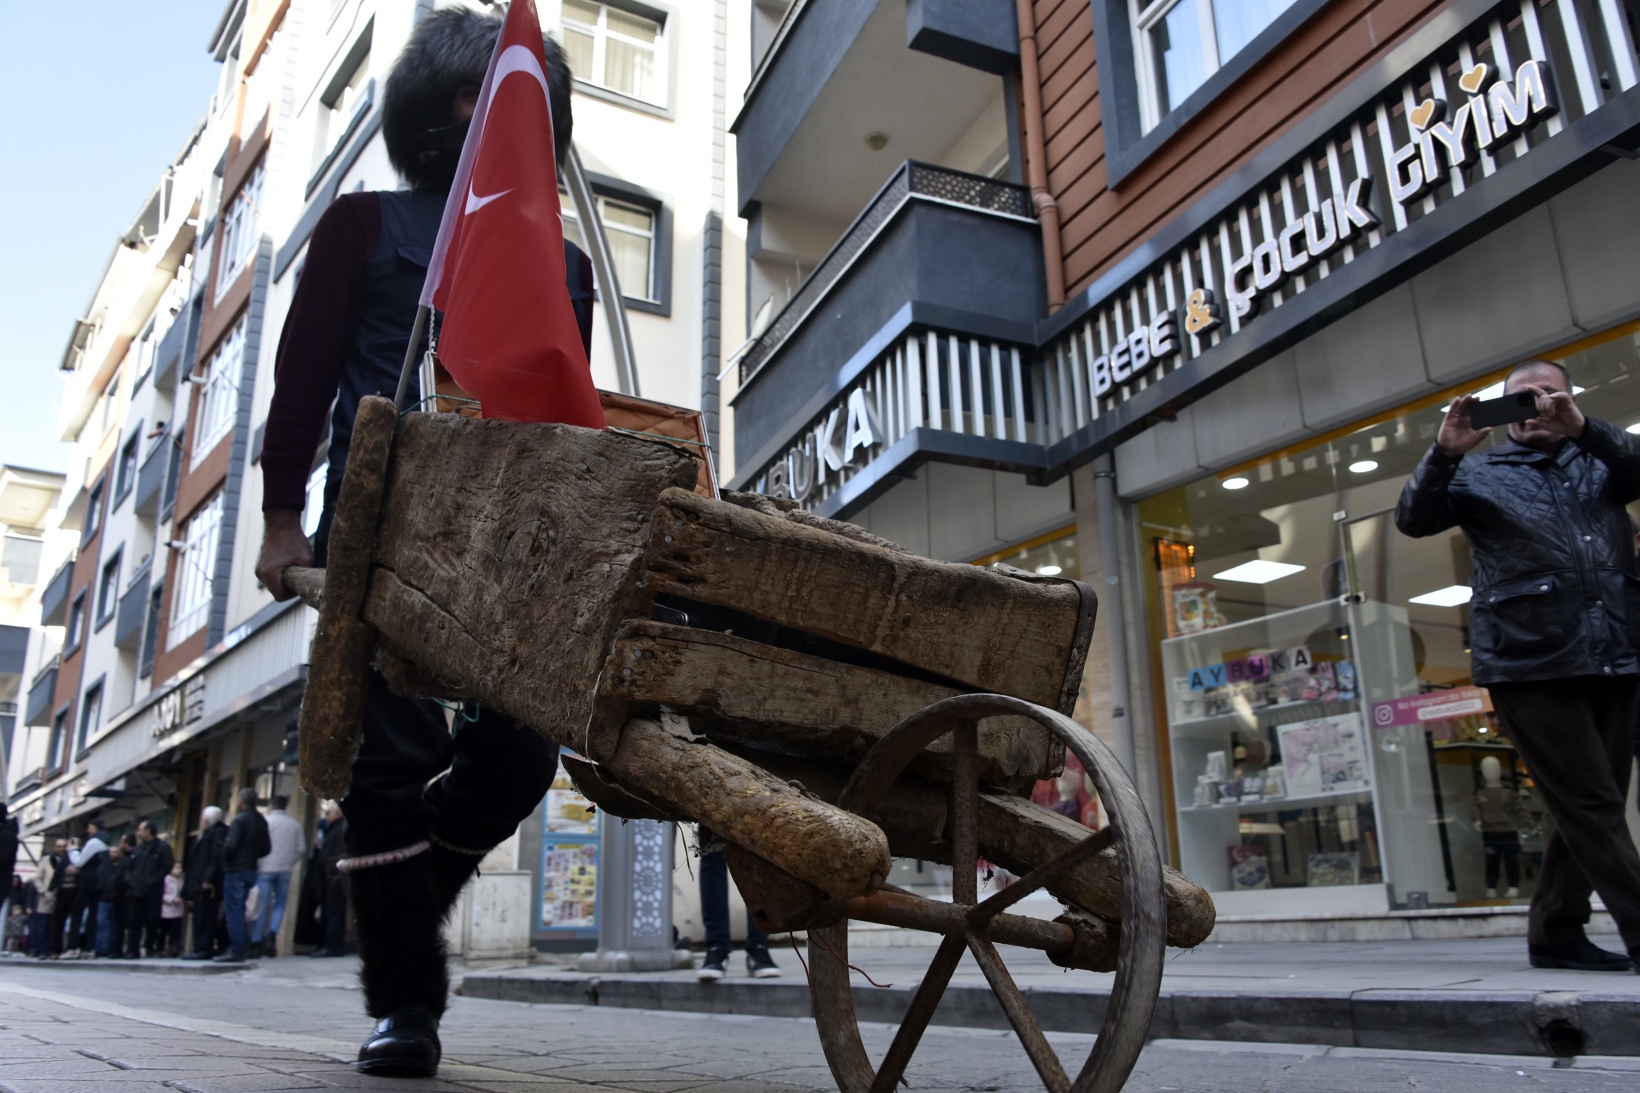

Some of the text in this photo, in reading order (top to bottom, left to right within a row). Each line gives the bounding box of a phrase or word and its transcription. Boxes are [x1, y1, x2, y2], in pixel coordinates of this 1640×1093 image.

[1092, 310, 1174, 397] BEBE
[1185, 288, 1215, 334] &
[1225, 177, 1372, 317] ÇOCUK
[1190, 648, 1309, 689] AYBUKA
